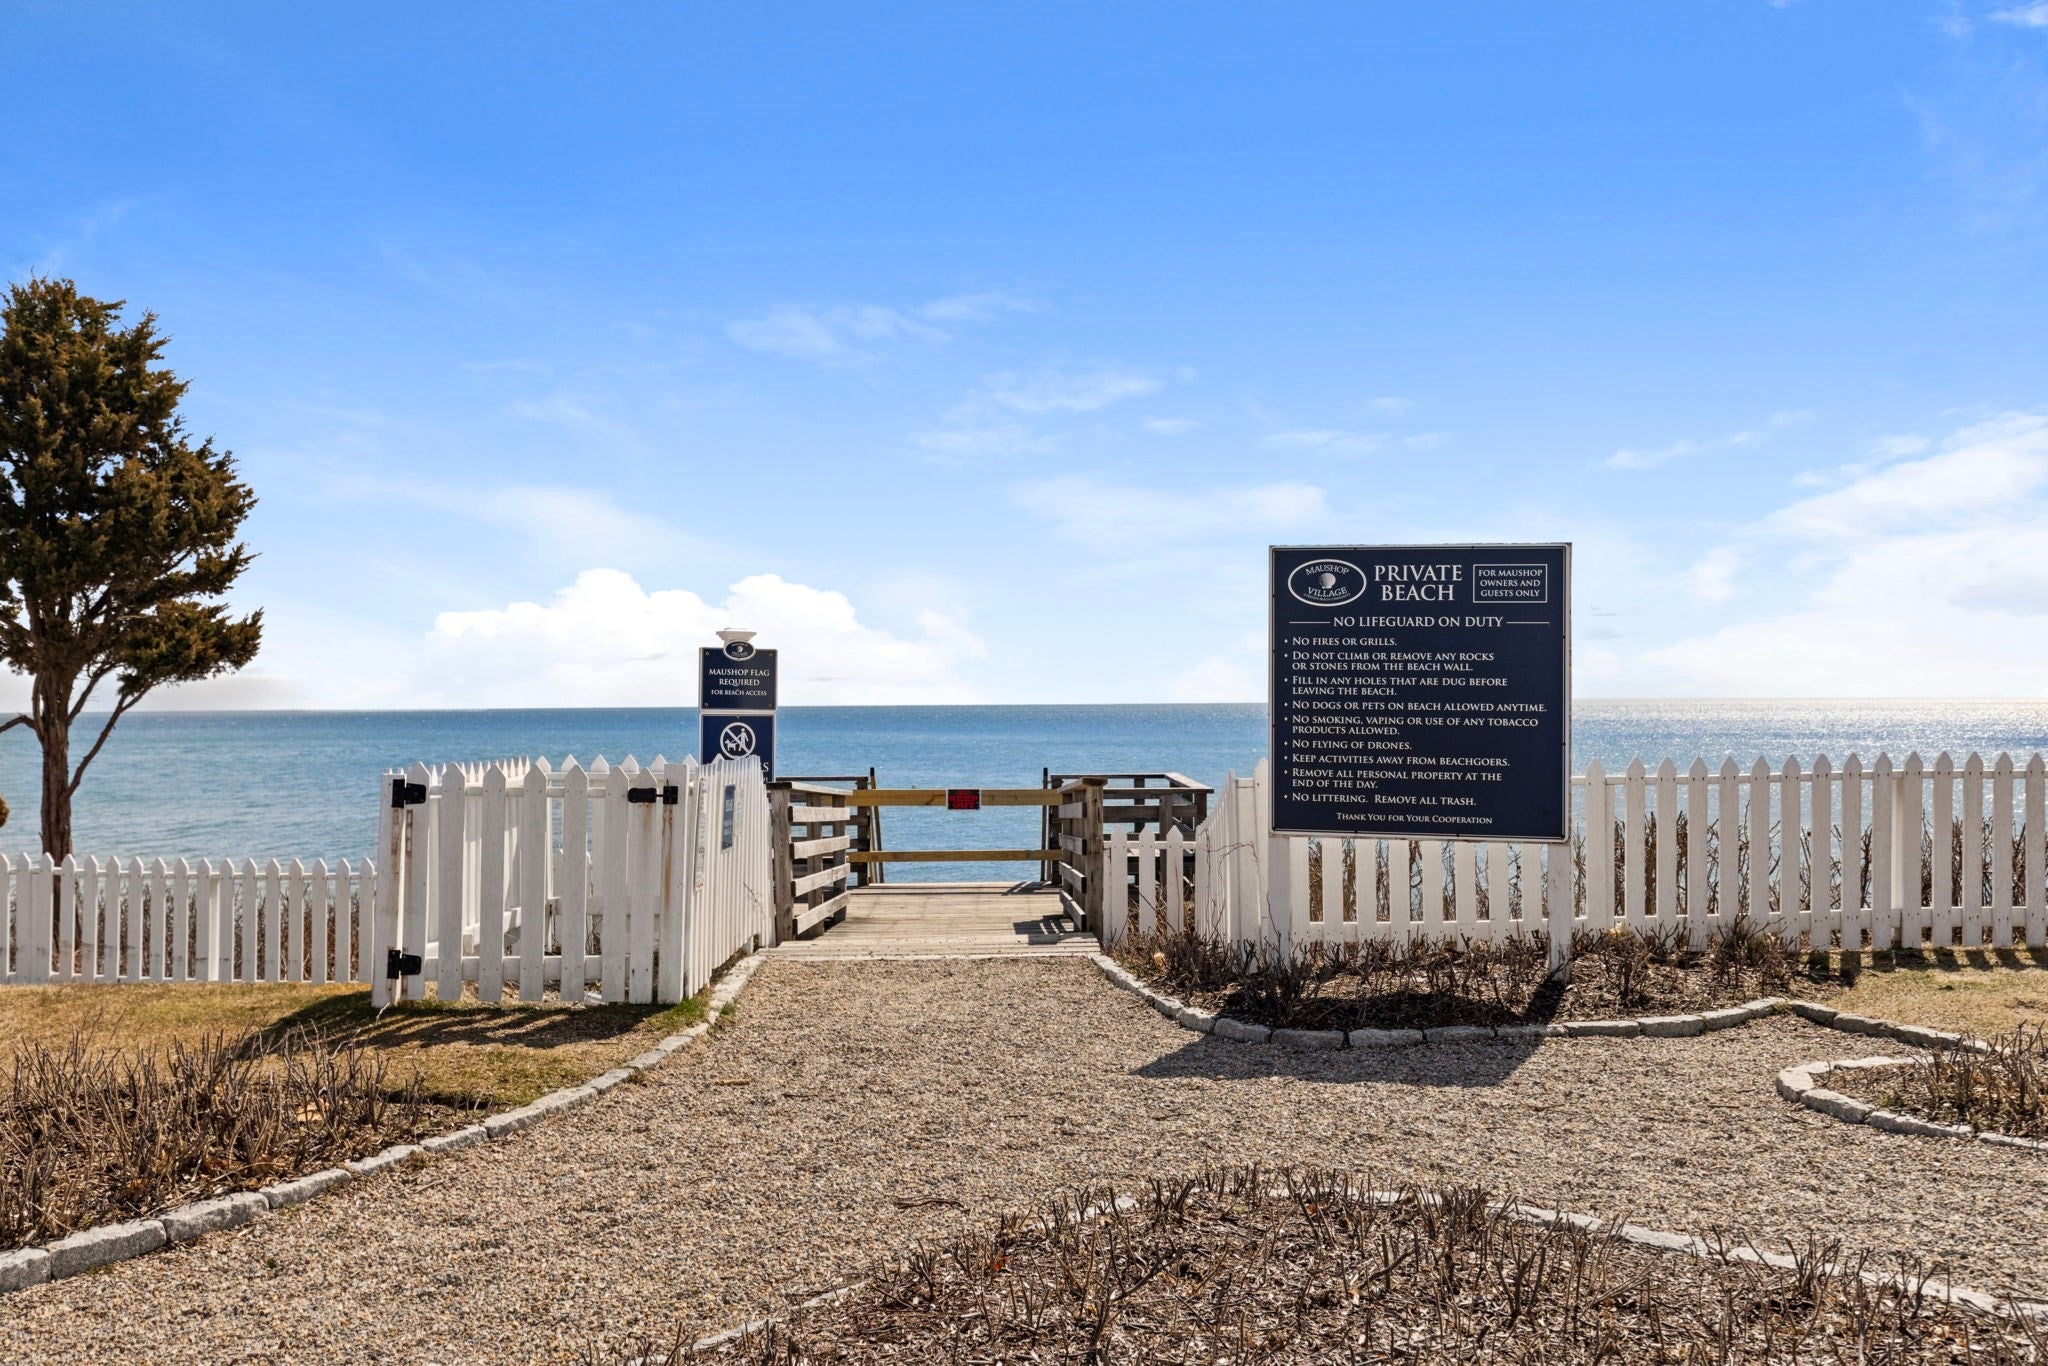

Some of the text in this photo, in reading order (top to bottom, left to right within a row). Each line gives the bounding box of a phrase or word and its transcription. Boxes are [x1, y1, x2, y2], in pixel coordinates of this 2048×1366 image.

[1305, 564, 1349, 576] MAUSHOP
[1374, 565, 1463, 582] PRIVATE
[1478, 569, 1543, 577] FOR MAUSHOP
[1480, 579, 1540, 587] OWNERS AND
[1308, 586, 1348, 597] VILLAGE
[1381, 584, 1455, 601] BEACH
[1480, 589, 1540, 597] GUESTS ONLY
[1334, 616, 1503, 627] NO LIFEGUARD ON DUTY
[1359, 638, 1397, 646] GRILLS.
[1313, 652, 1334, 660] NOT
[1337, 652, 1369, 660] CLIMB
[1460, 653, 1494, 661] ROCKS
[1292, 662, 1307, 670] OR
[1309, 662, 1348, 670] STONES
[1407, 663, 1440, 671] BEACH
[1444, 663, 1473, 671] WALL.
[708, 668, 770, 677] MAUSHOP FLAG
[719, 678, 760, 687] REQUIRED
[1354, 677, 1387, 685] HOLES
[1469, 678, 1507, 686] BEFORE
[1337, 687, 1357, 695] THE
[1362, 702, 1385, 710] PETS
[1388, 702, 1404, 710] ON
[1408, 702, 1441, 710] BEACH
[1444, 703, 1494, 711] ALLOWED
[1496, 704, 1547, 712] ANYTIME.
[1407, 717, 1422, 725] OR
[1425, 717, 1443, 725] USE
[1463, 718, 1485, 726] ANY
[1488, 718, 1538, 727] TOBACCO
[1293, 726, 1399, 735] PRODUCTS ALLOWED.
[1351, 741, 1364, 749] OF
[1319, 755, 1374, 763] ACTIVITIES
[1376, 756, 1404, 764] AWAY
[1407, 757, 1436, 765] FROM
[1440, 757, 1510, 766] BEACHGOERS.
[1357, 770, 1408, 779] PERSONAL
[1412, 772, 1463, 780] PROPERTY
[1481, 773, 1501, 781] THE
[1293, 779, 1314, 787] END
[1334, 780, 1352, 788] THE
[1313, 794, 1368, 803] LITTERING.
[1440, 797, 1476, 805] TRASH.
